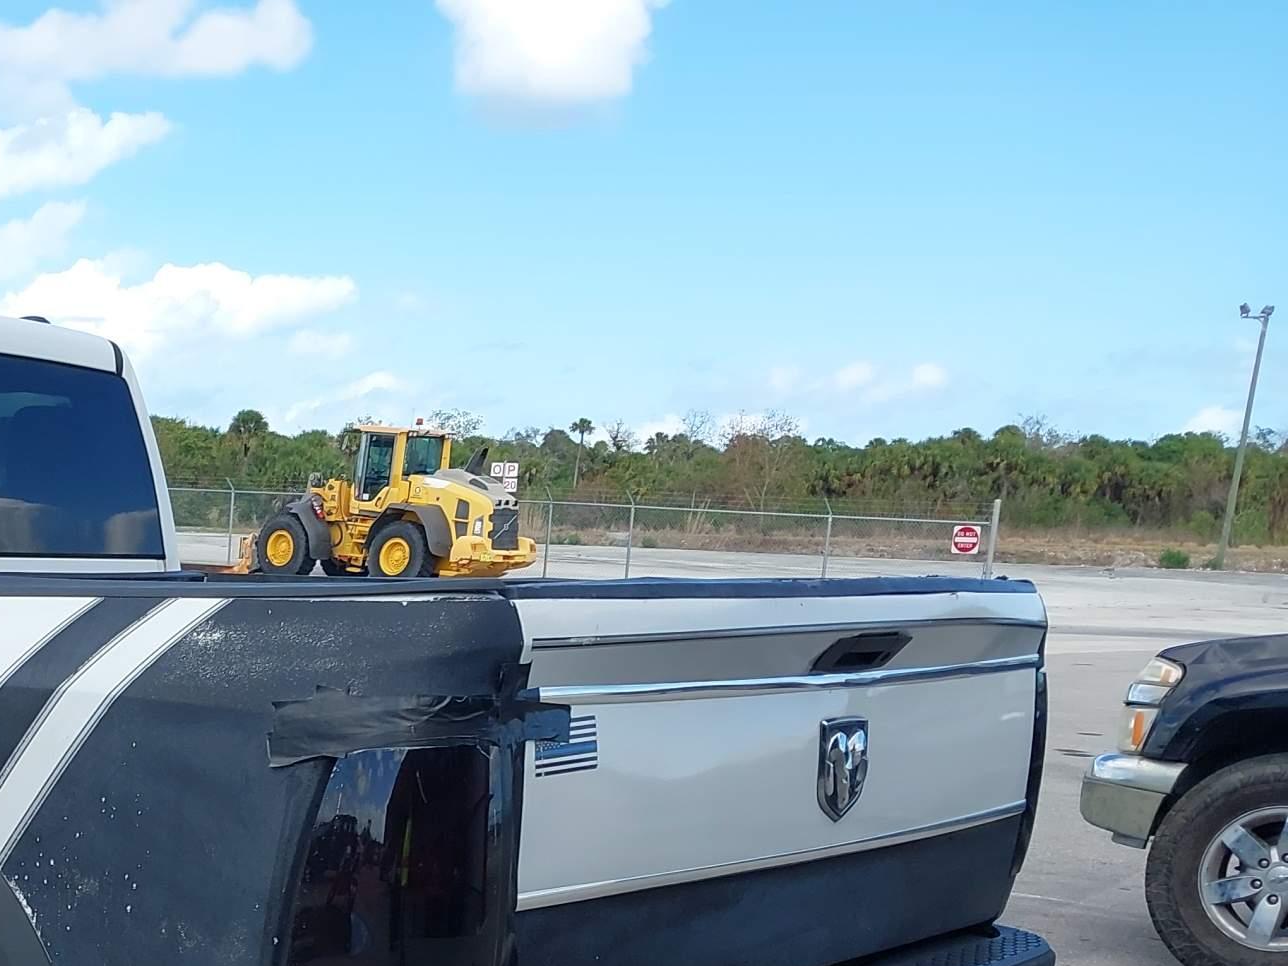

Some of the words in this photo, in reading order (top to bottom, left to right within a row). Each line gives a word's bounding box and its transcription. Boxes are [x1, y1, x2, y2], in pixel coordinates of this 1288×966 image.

[493, 464, 502, 475] O
[507, 464, 516, 476] P
[503, 480, 516, 490] 20
